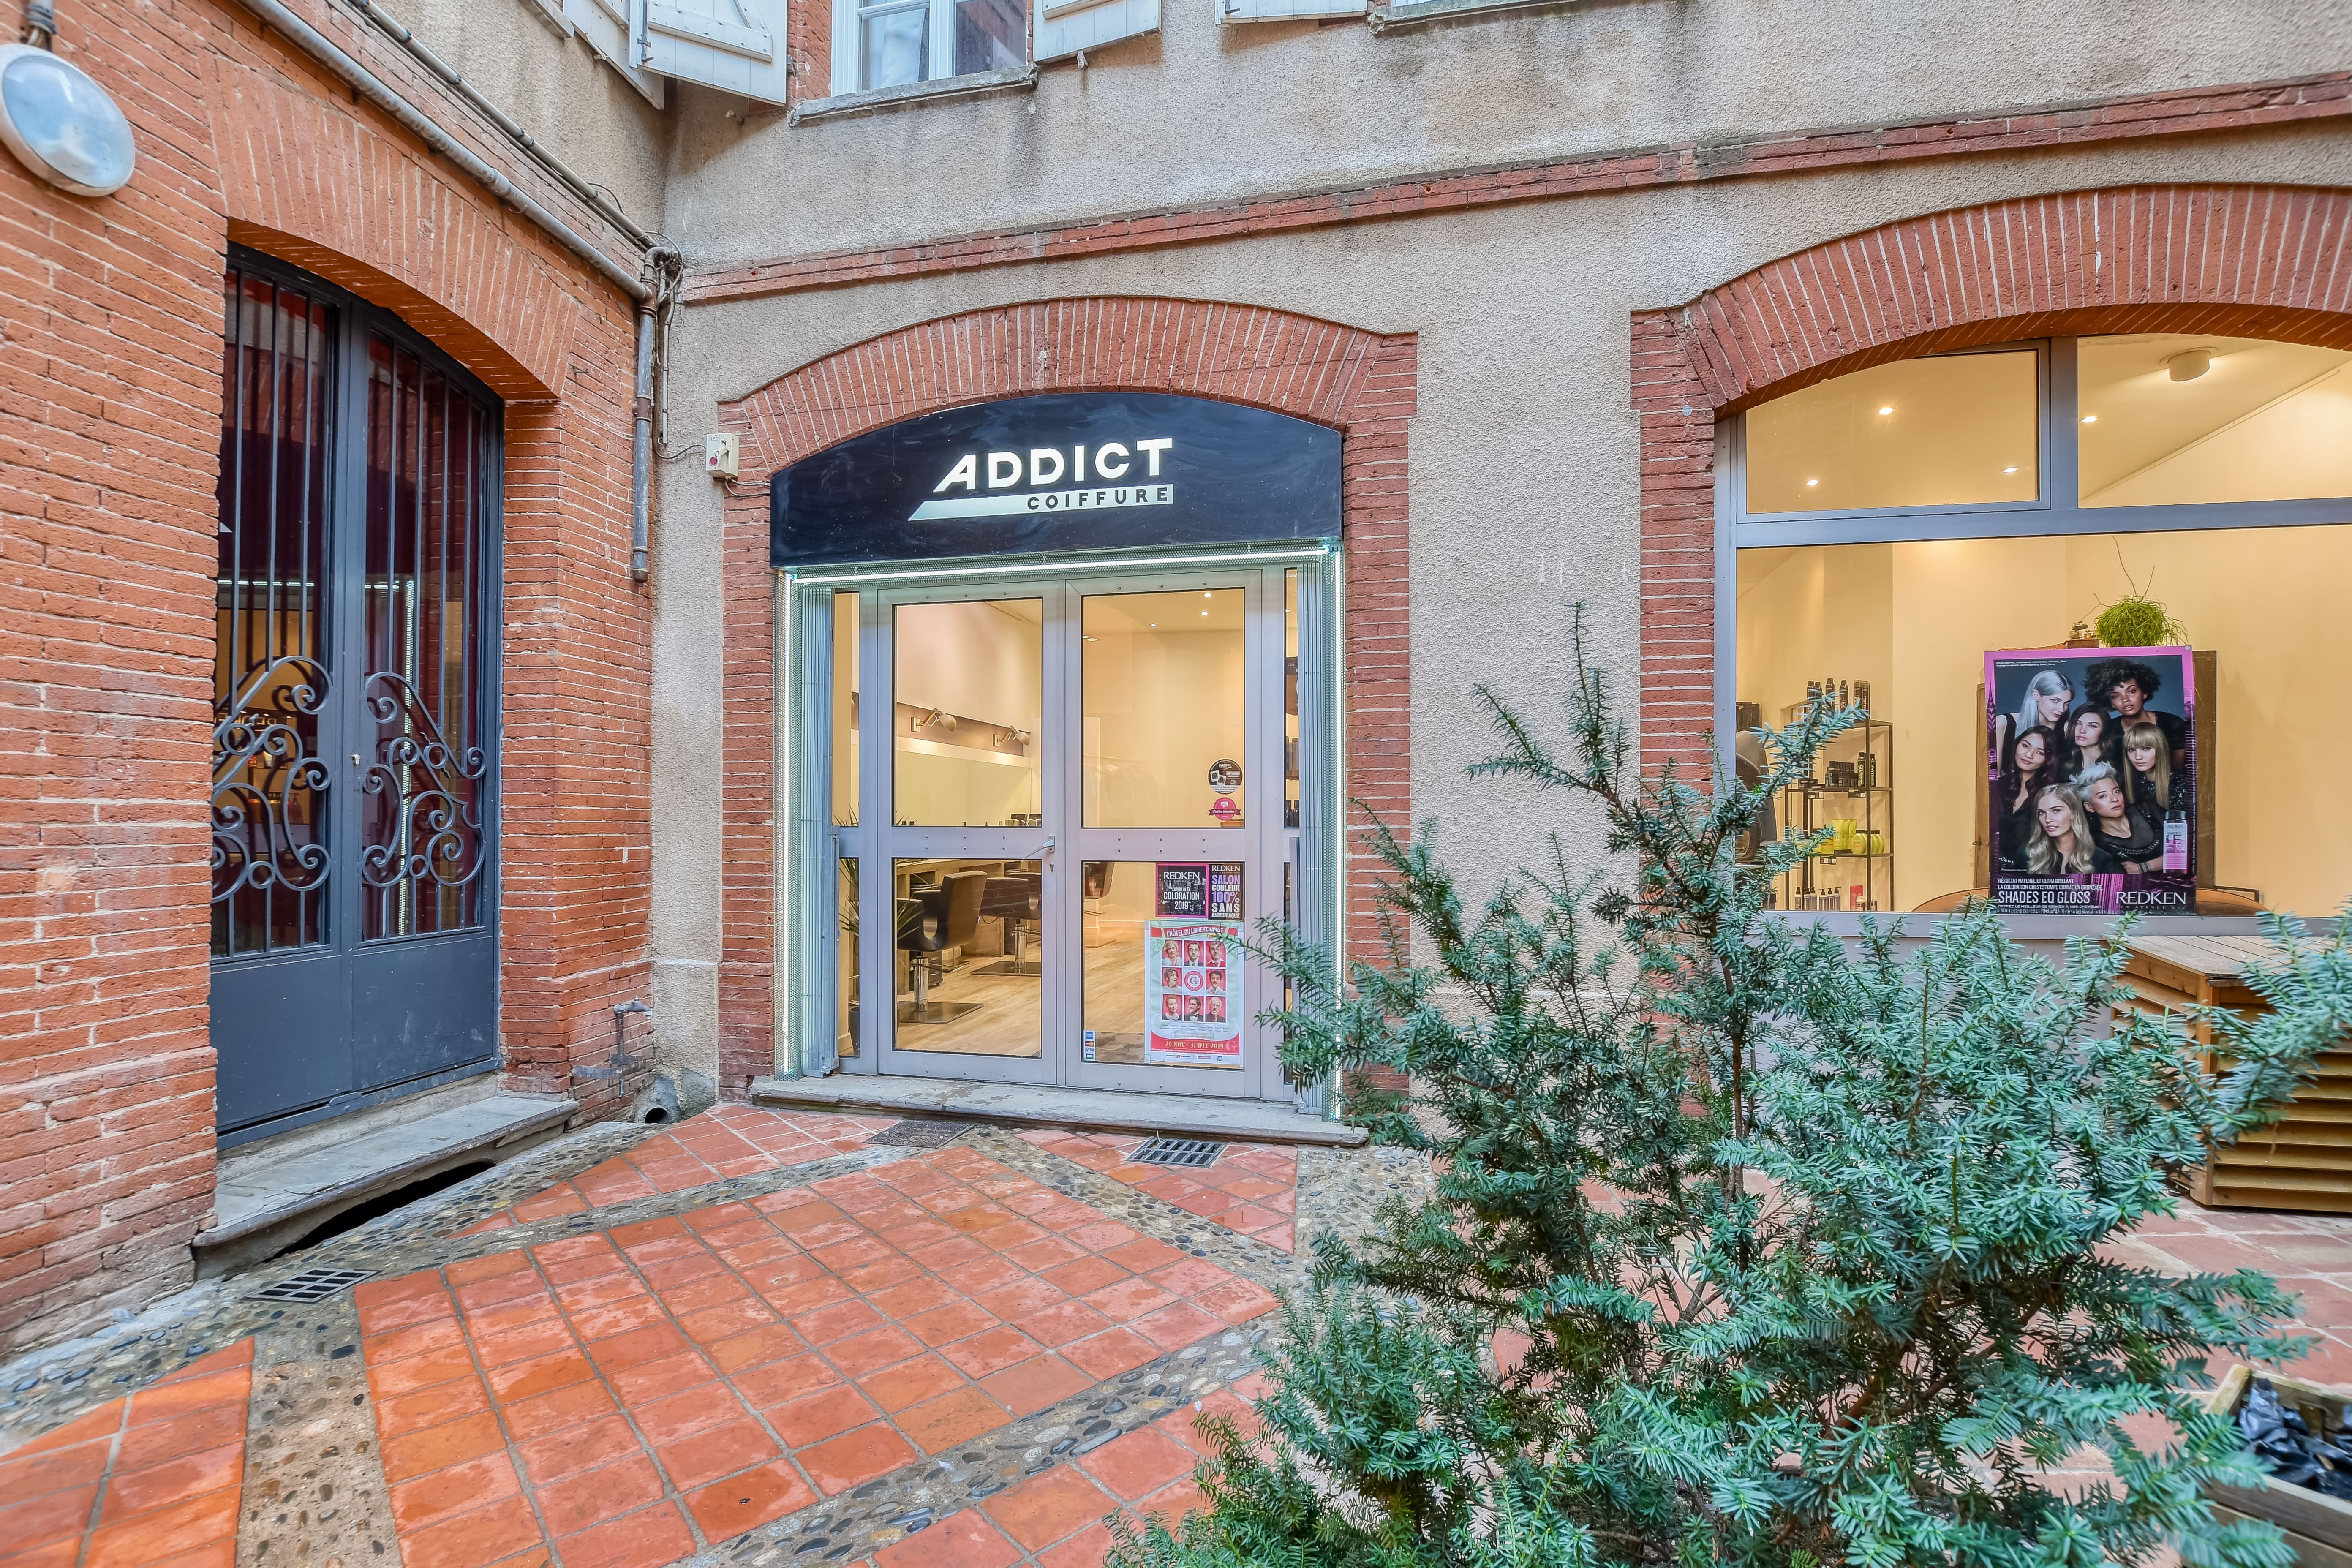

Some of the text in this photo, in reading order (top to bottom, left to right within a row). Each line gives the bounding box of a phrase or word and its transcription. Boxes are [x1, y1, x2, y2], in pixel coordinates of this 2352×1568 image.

[933, 438, 1173, 493] ADDICT
[1027, 487, 1168, 510] COIFFURE
[1163, 871, 1200, 880] REDKEN
[1211, 874, 1240, 885] SALON
[1163, 892, 1200, 900] COLORATION
[1211, 891, 1240, 903] 100%
[1998, 891, 2091, 904] SHADES EQ GLOSS
[2115, 892, 2186, 904] REDKEN
[1174, 901, 1189, 910] 2019
[1211, 903, 1240, 913] SANS
[1166, 929, 1184, 937] L'HÔTEL
